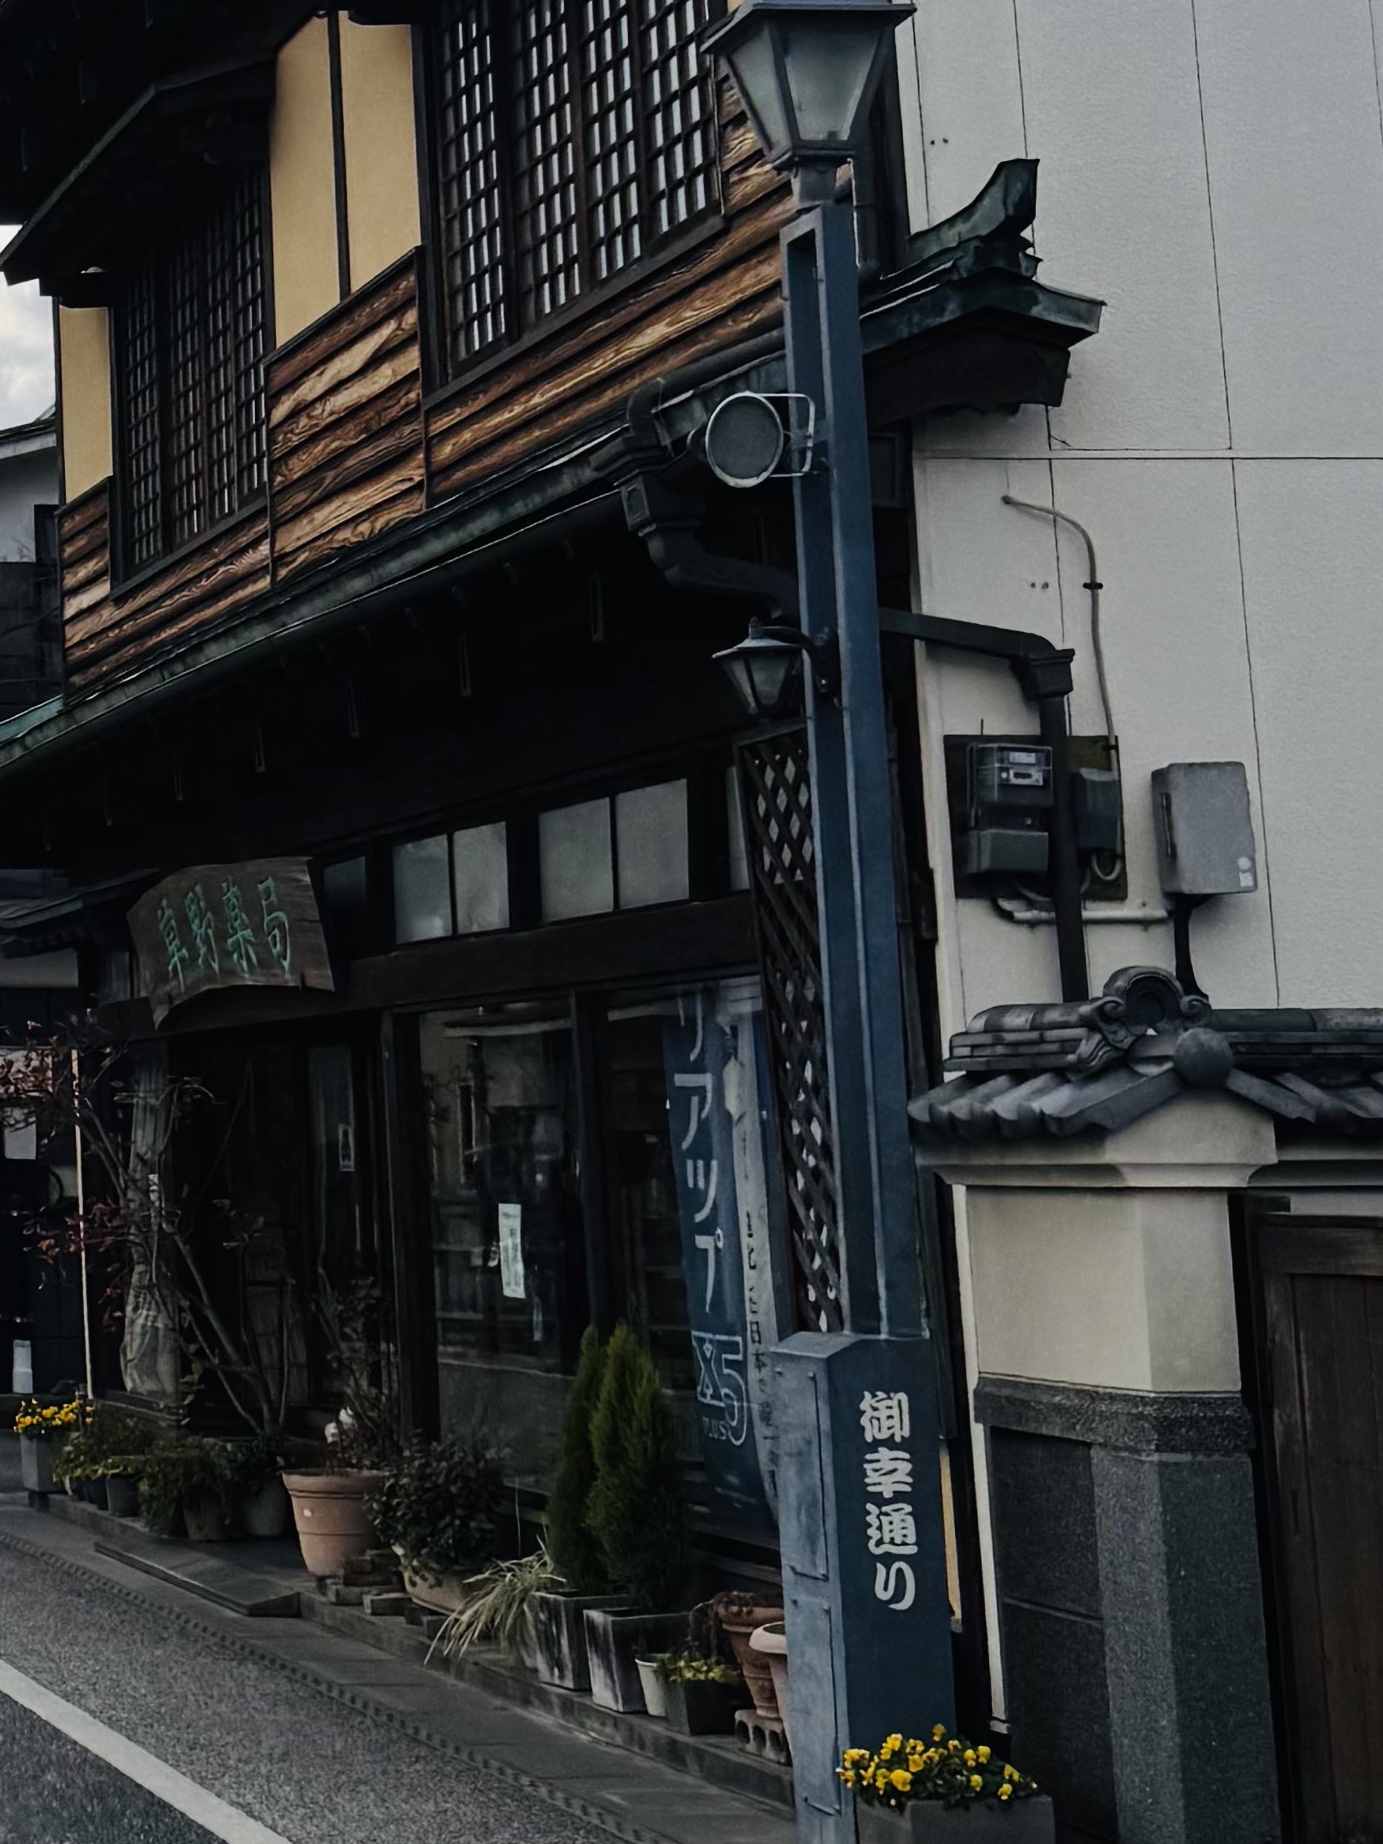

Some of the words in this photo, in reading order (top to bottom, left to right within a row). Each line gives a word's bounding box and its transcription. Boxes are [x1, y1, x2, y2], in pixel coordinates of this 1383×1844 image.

[156, 876, 291, 994] 草野薬局
[859, 1391, 919, 1611] 御幸通り
